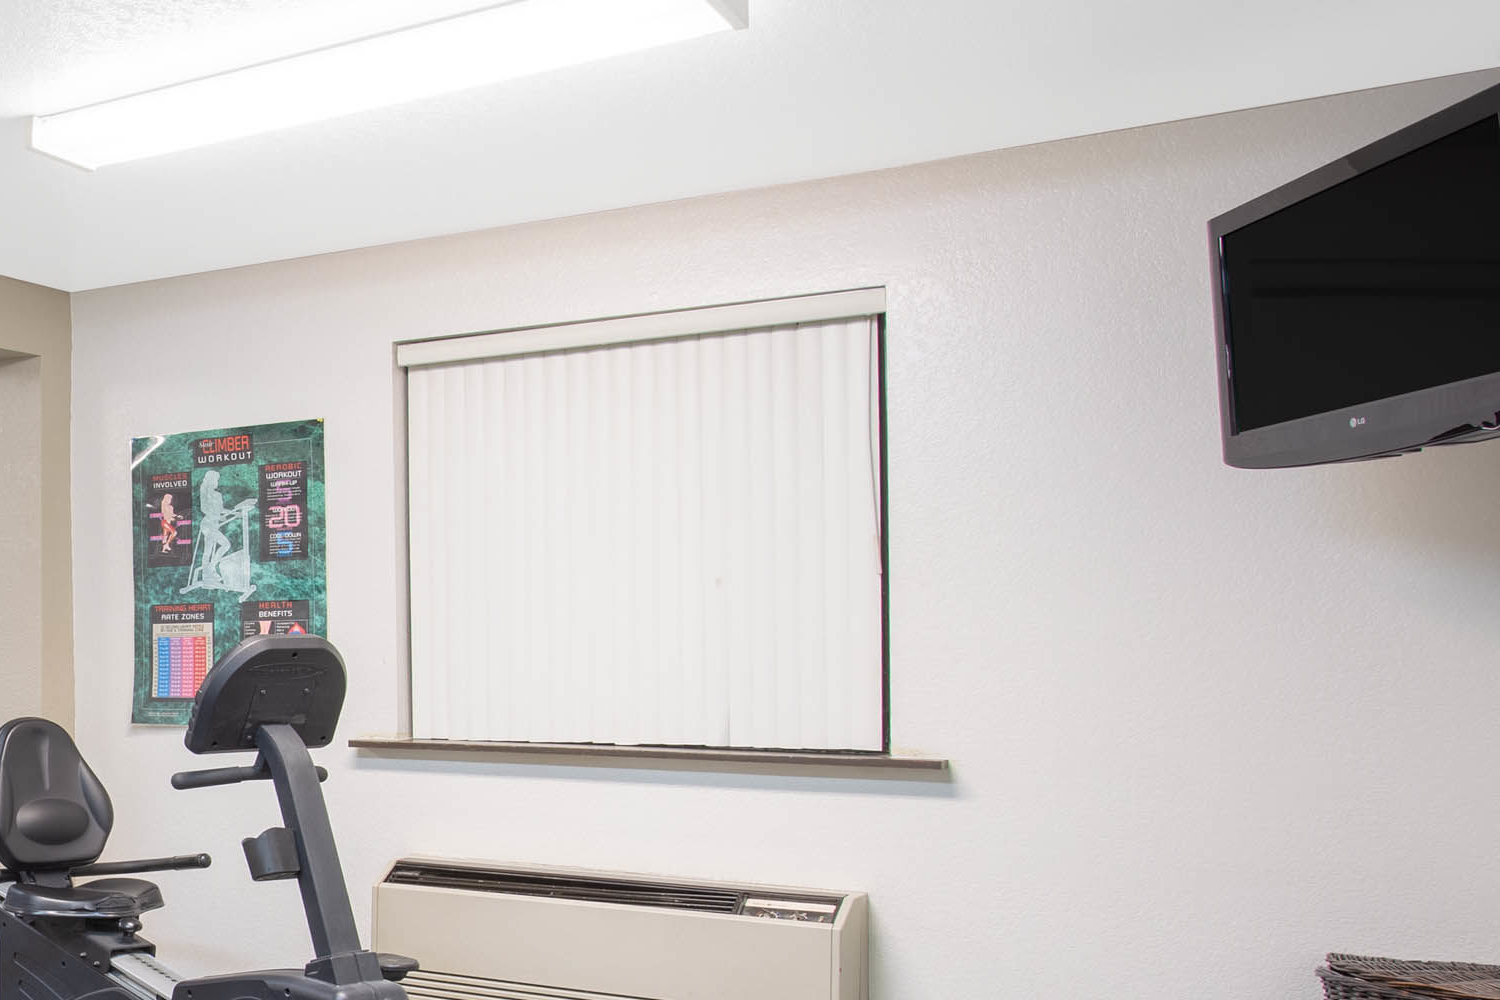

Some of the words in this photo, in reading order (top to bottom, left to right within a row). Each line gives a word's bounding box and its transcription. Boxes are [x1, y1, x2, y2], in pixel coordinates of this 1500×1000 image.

[197, 451, 252, 464] WORKOUT
[265, 470, 302, 480] WORKOUT
[153, 480, 187, 489] INVOLVED
[268, 504, 301, 529] 20
[259, 601, 293, 609] HEALTH
[161, 613, 179, 621] RATE
[181, 612, 205, 620] ZONES
[258, 609, 293, 618] BENEFITS
